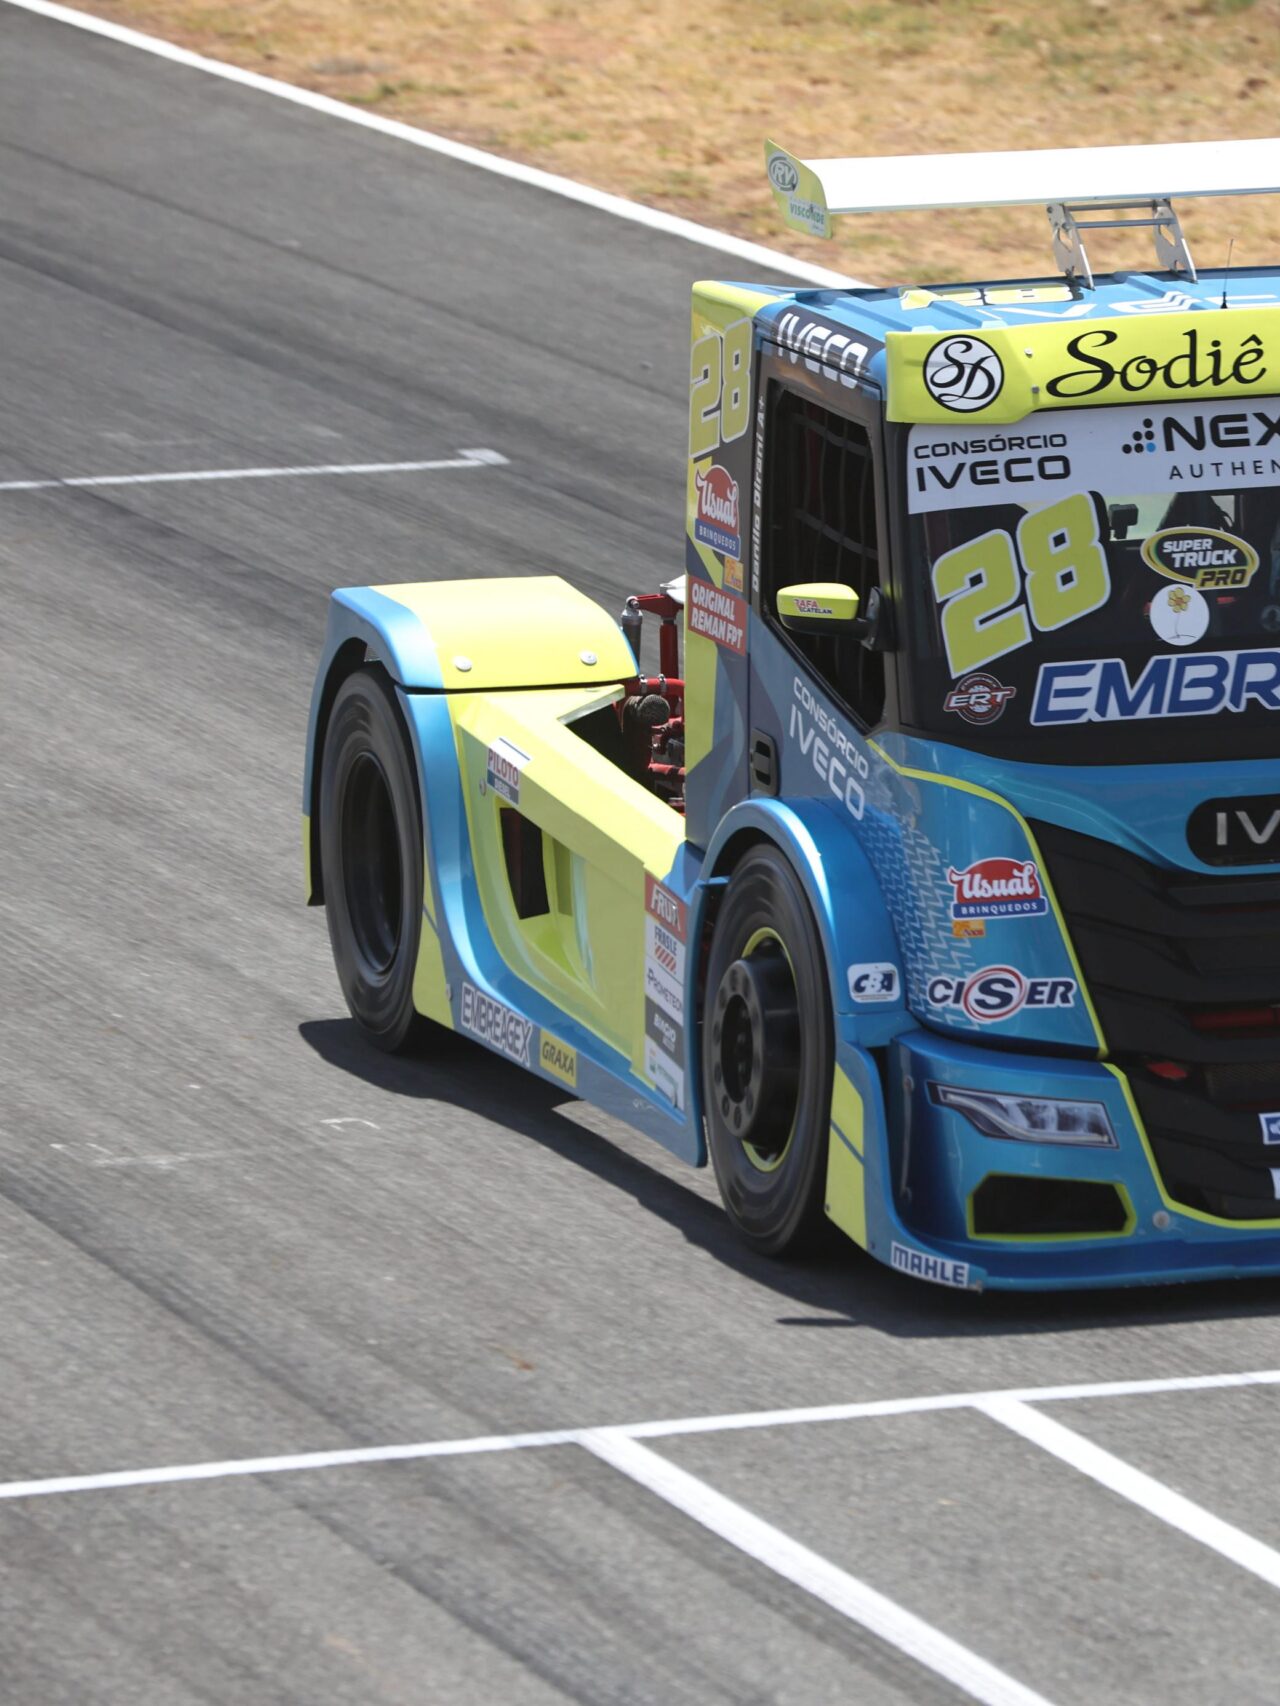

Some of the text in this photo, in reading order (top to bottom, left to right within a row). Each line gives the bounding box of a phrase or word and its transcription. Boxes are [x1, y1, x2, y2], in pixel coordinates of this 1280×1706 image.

[777, 312, 868, 389] IVECO
[1046, 328, 1268, 398] Sodiê
[689, 317, 753, 458] 28
[913, 432, 1068, 460] CONSÓRCIO
[915, 455, 1072, 492] IVECO
[697, 476, 738, 528] Usual
[698, 524, 737, 552] BRINQUEDOS
[1162, 538, 1214, 553] SUPER
[1171, 548, 1239, 568] TRUCK
[1199, 568, 1247, 587] PRO
[691, 582, 736, 622] ORIGINAL
[932, 490, 1111, 680] 28
[691, 606, 743, 650] REMAN FPT
[949, 690, 1011, 707] ERT
[793, 676, 869, 779] CONSÓRCIO
[487, 748, 519, 787] PILOTO
[789, 703, 865, 821] IVECO
[951, 864, 1036, 899] Usual
[960, 902, 1039, 915] BRINQUEDOS
[928, 974, 1075, 1012] CISER
[462, 982, 532, 1067] EMBREAGEX
[541, 1041, 575, 1078] GRAXA
[893, 1244, 966, 1285] MAHLE
